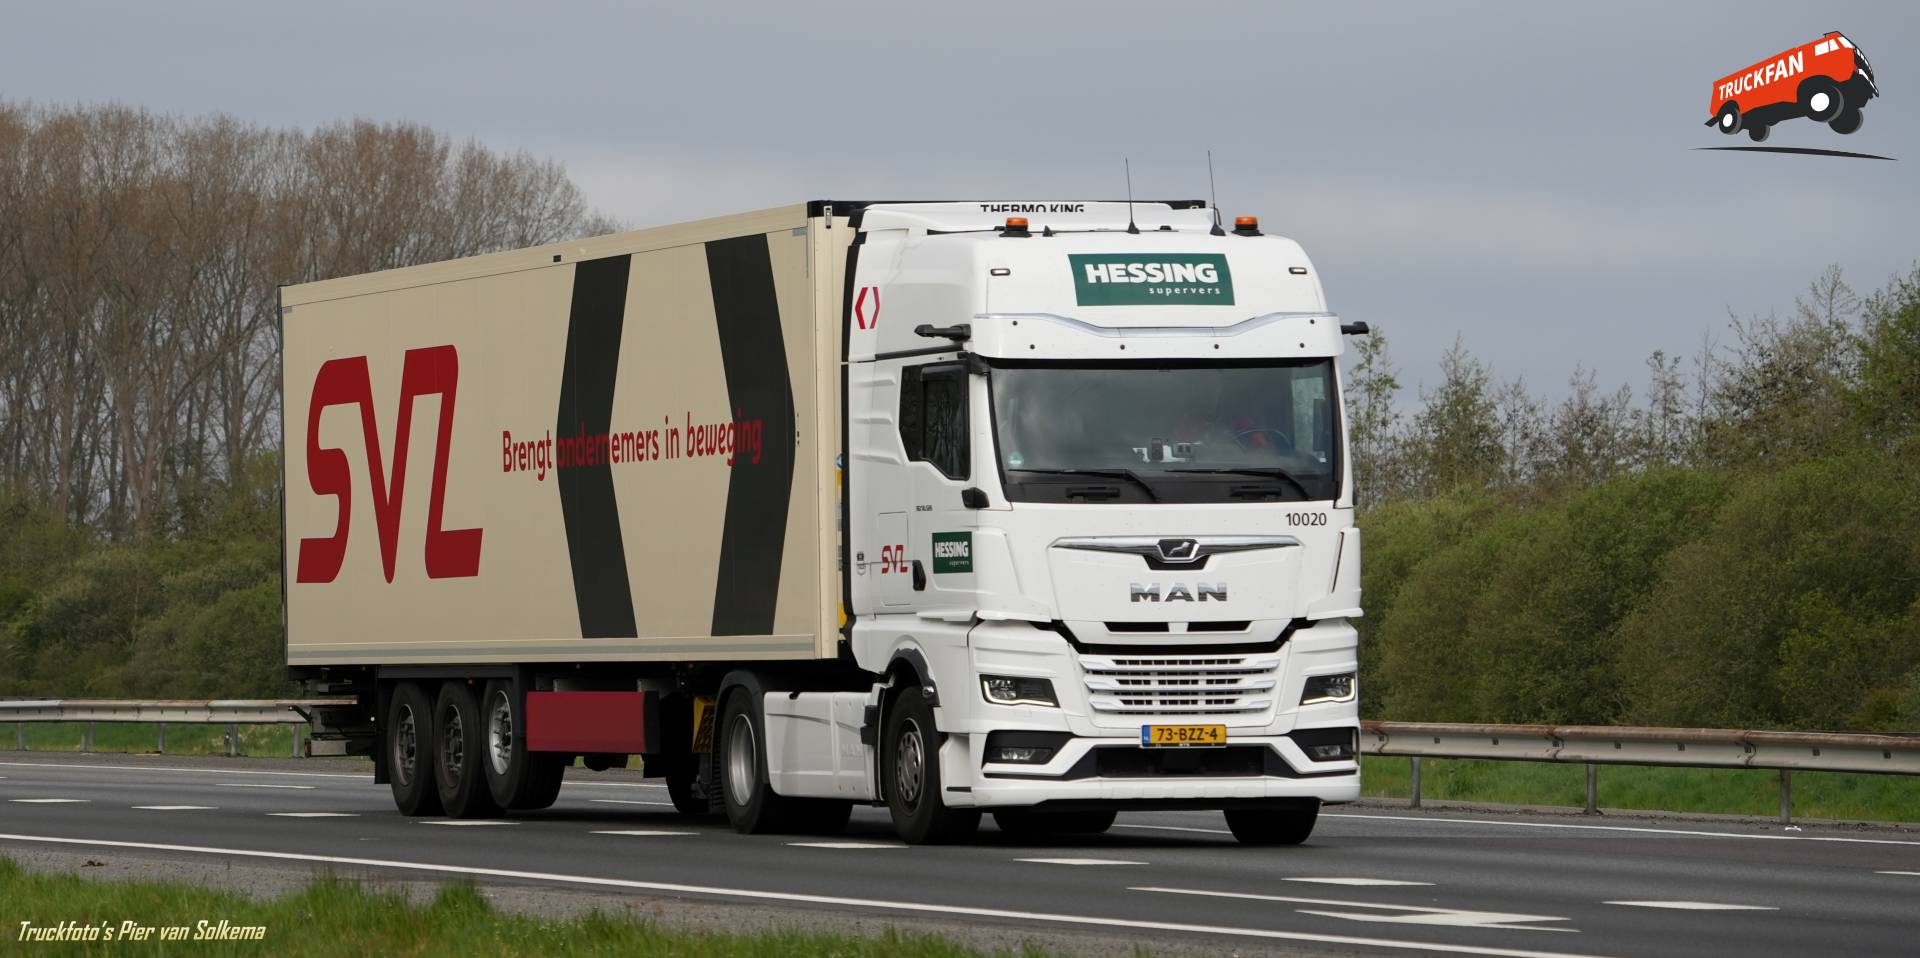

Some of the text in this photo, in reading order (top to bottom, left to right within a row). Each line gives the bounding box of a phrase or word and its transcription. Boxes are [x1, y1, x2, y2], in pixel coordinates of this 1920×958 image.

[1084, 263, 1219, 283] HESSING
[1148, 287, 1221, 296] supervers
[502, 407, 764, 481] Brengt ondernemers in beweging
[1285, 512, 1327, 526] 10020
[935, 541, 969, 558] HESSING
[1130, 582, 1227, 602] MAN
[1157, 727, 1218, 741] 73-BZZ-4
